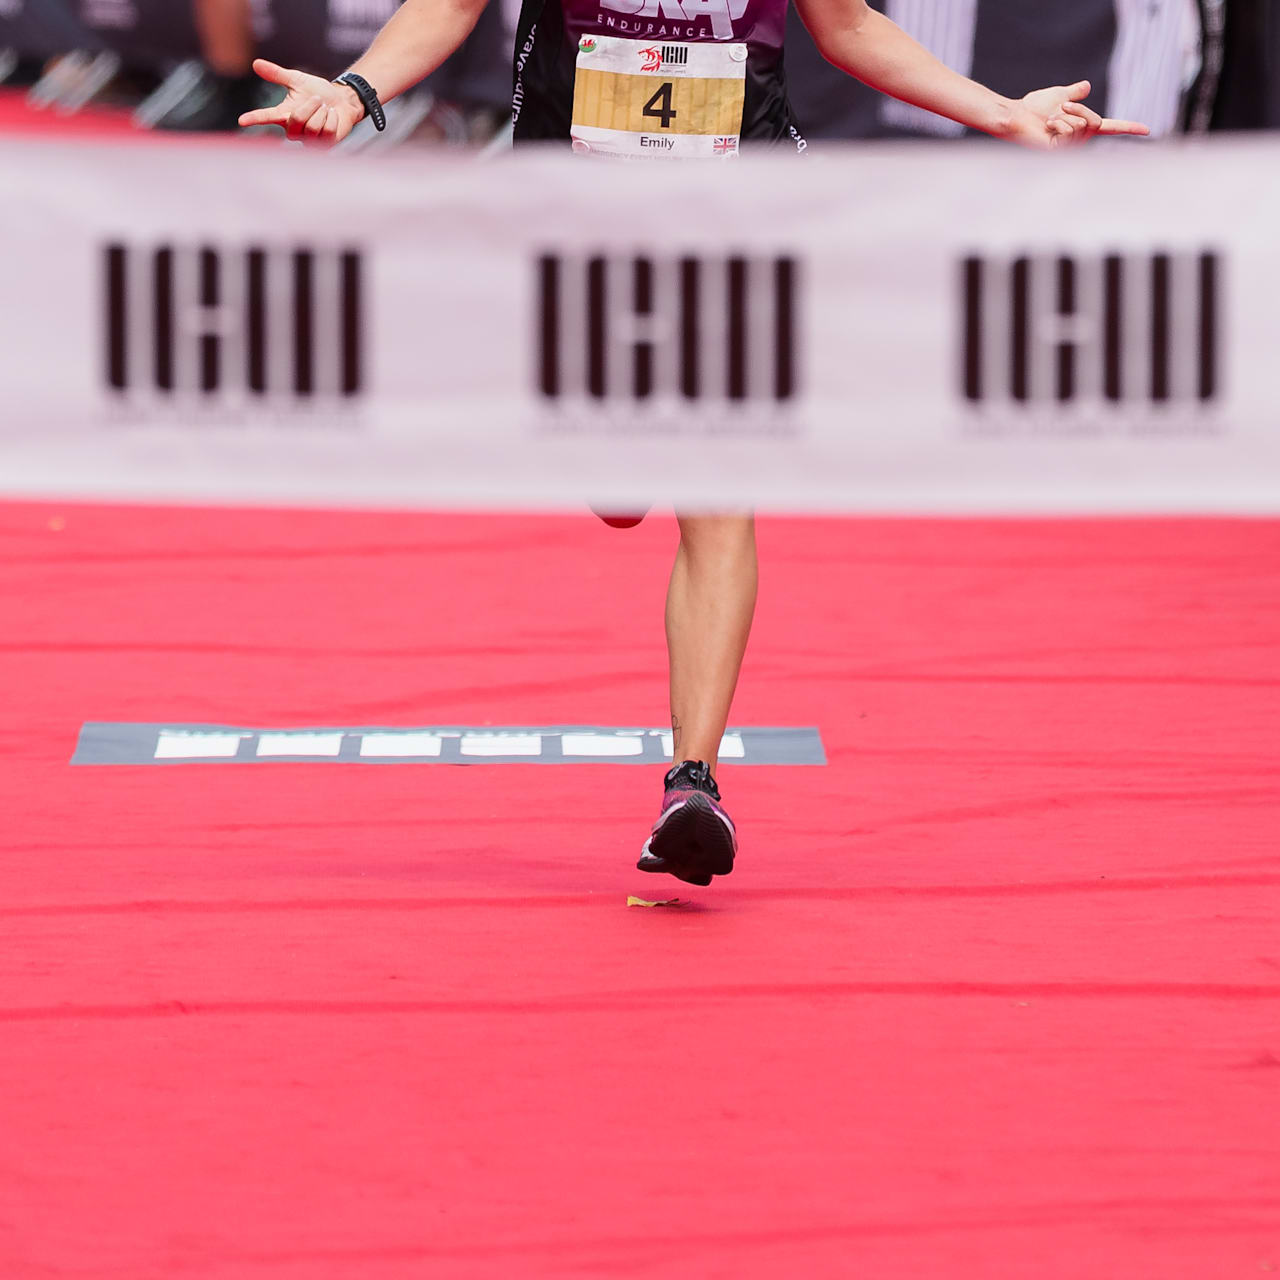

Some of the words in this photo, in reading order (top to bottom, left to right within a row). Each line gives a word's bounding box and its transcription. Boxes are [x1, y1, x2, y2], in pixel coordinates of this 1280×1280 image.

[597, 13, 707, 38] ENDURANCE
[642, 82, 677, 128] 4
[639, 135, 675, 151] Emily
